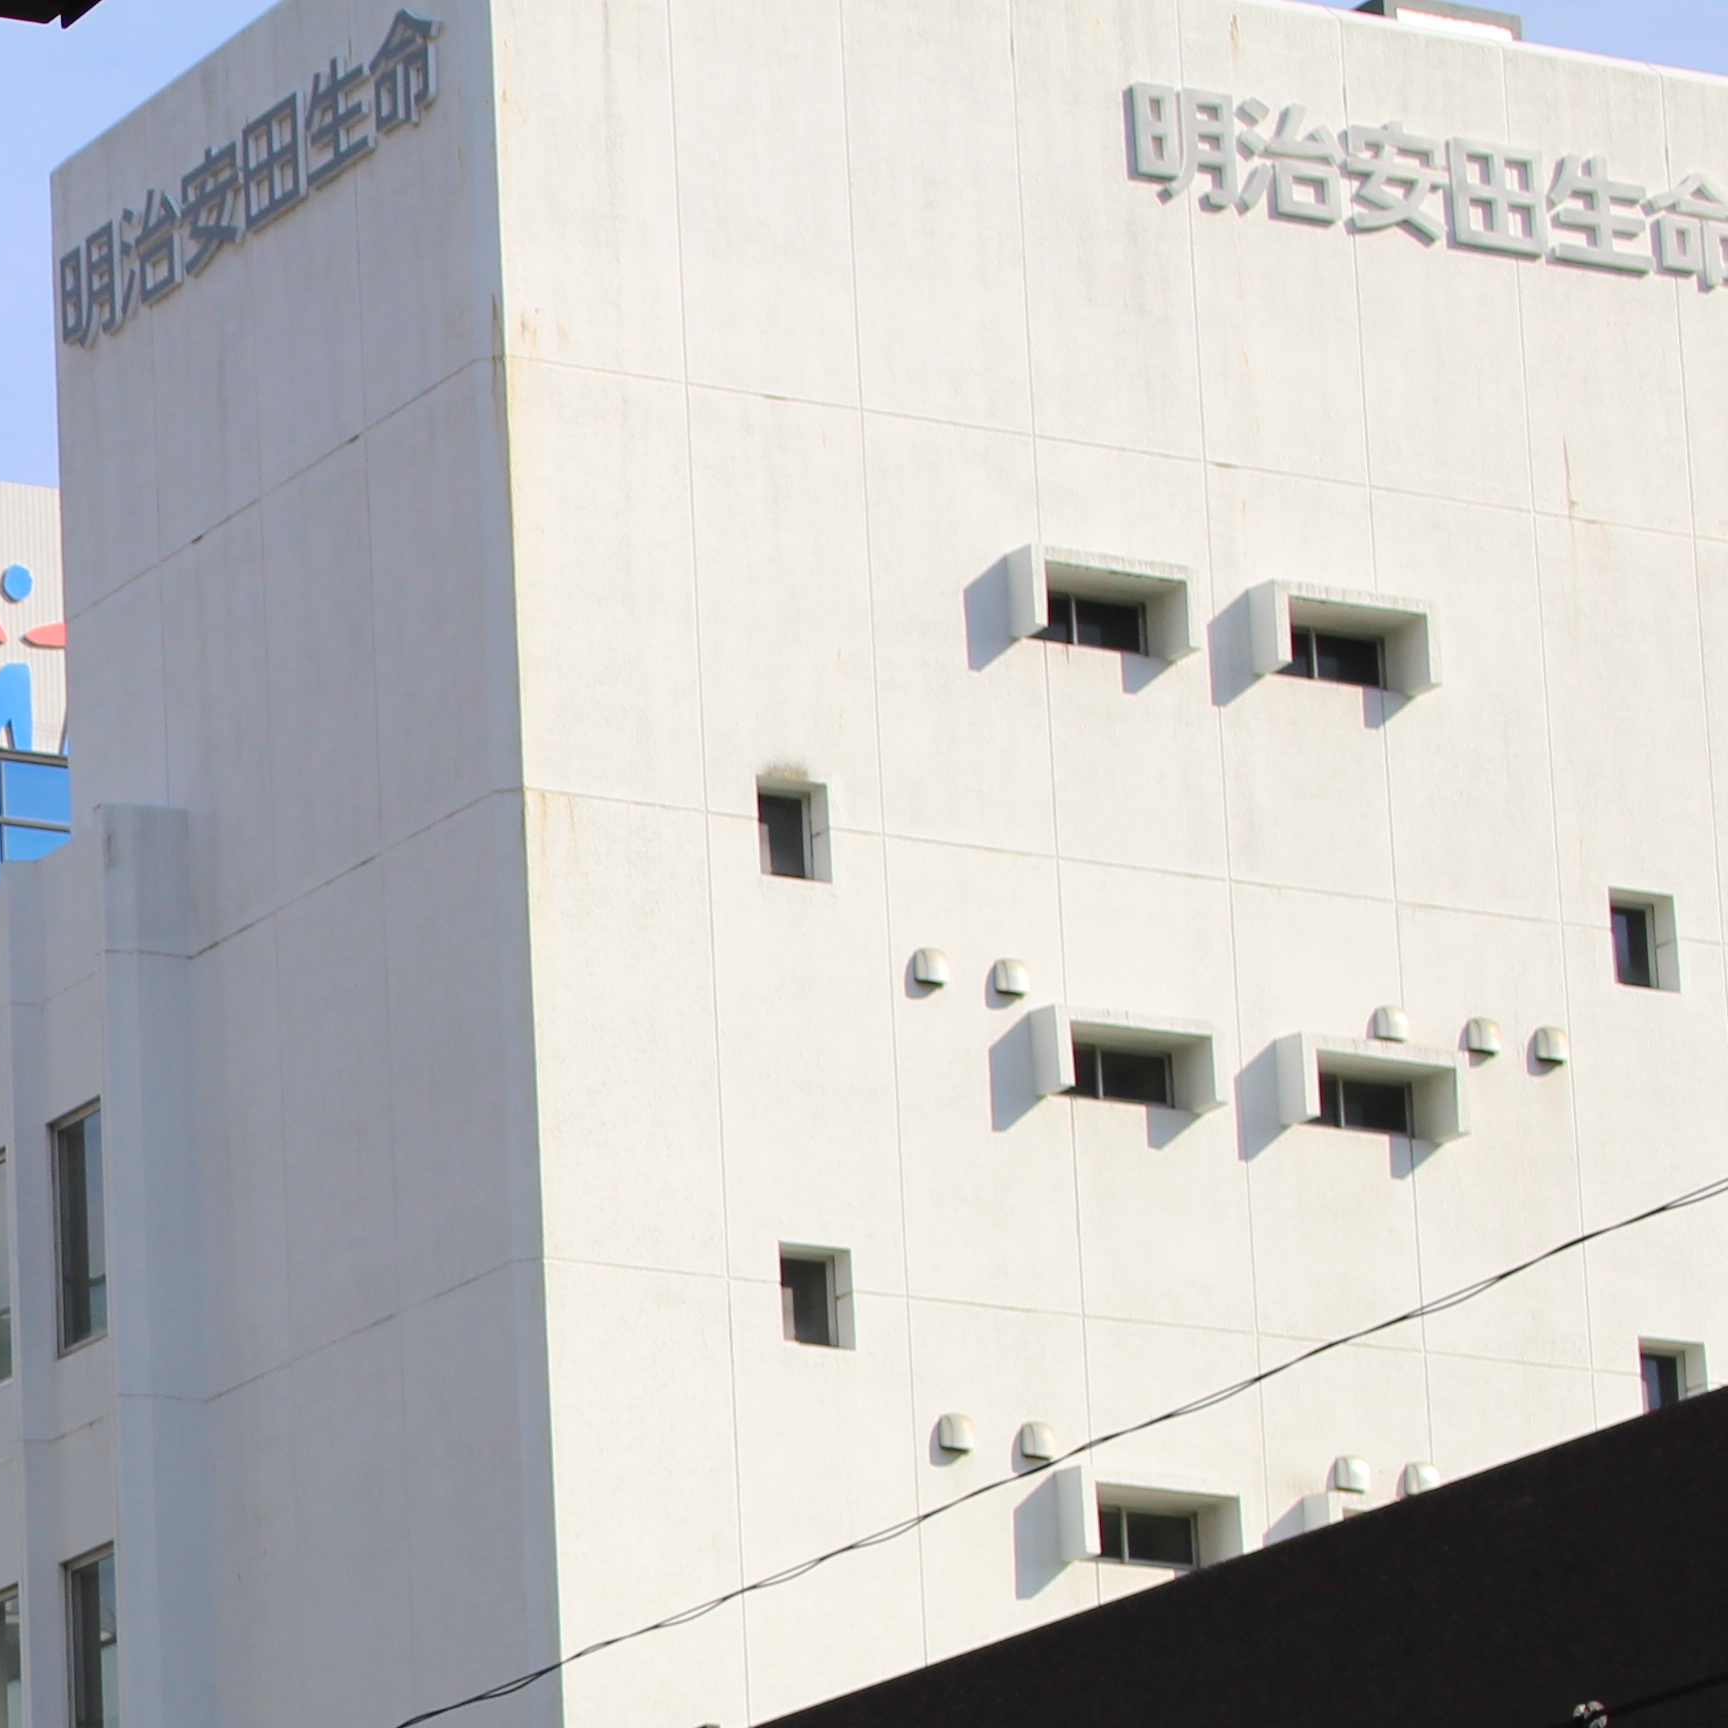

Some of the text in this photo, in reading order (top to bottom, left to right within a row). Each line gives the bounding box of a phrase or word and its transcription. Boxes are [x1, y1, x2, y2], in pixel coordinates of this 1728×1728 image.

[60, 8, 442, 349] 明治安田生命
[1123, 82, 1728, 293] 明治安田生命
